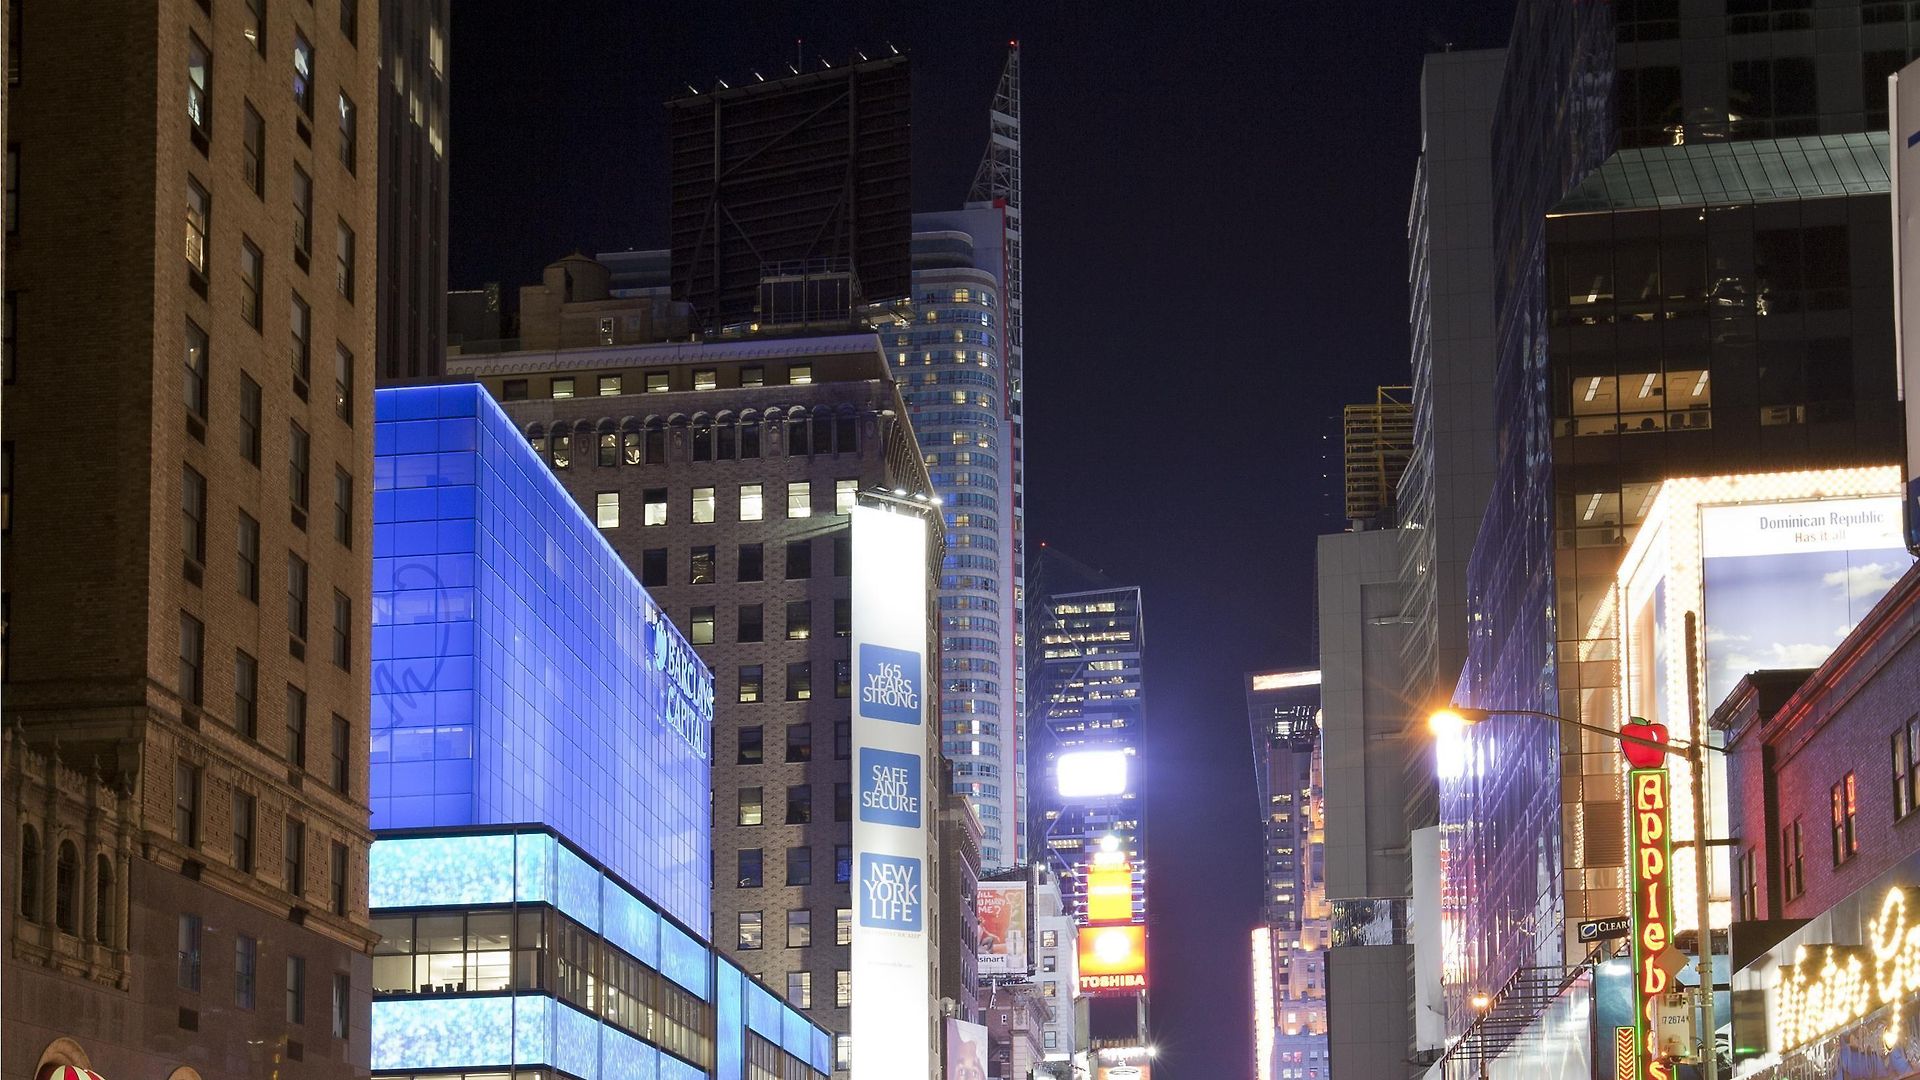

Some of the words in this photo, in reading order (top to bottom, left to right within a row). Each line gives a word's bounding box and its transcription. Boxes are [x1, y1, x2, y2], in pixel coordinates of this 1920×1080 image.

[1760, 514, 1825, 530] Dominican
[1829, 510, 1884, 527] Republic
[1795, 531, 1816, 543] Has
[666, 638, 715, 722] BARCLAYS
[877, 662, 902, 679] 165
[868, 673, 912, 694] YEARS
[863, 686, 918, 710] STRONG
[665, 685, 707, 759] CAPITAL
[872, 764, 908, 785] SAFE
[874, 776, 907, 798] AND
[862, 791, 918, 813] SECURE
[870, 861, 913, 885] NEW
[863, 879, 919, 905] YORK
[871, 899, 913, 922] LIFE
[1637, 773, 1668, 1080] Applebs
[978, 955, 1004, 963] sinart
[1080, 974, 1145, 988] TOSHIBA
